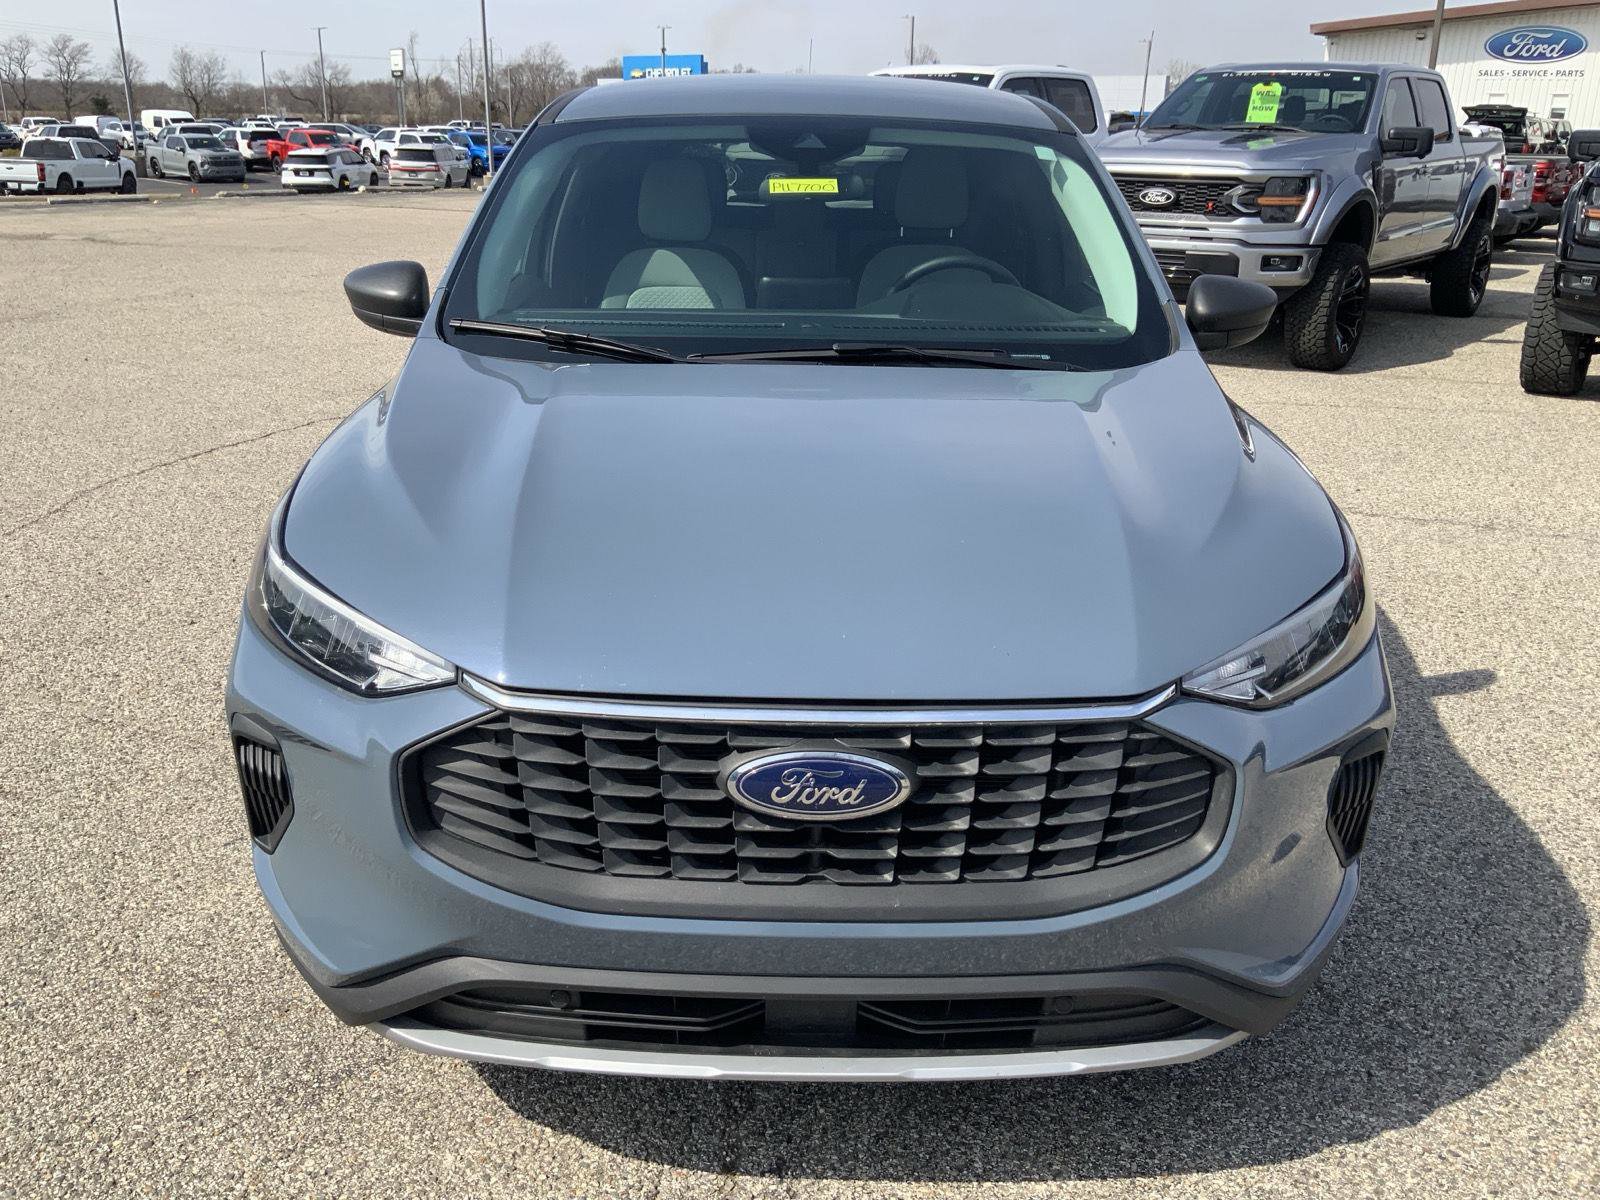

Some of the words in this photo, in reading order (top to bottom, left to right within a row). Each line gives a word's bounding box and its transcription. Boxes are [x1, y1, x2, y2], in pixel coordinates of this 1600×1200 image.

[1503, 31, 1568, 58] Ford
[1478, 69, 1505, 77] SALES
[1511, 69, 1548, 77] SERVICE
[1555, 69, 1585, 77] PARTS
[1145, 191, 1168, 202] Ford
[770, 767, 868, 805] Ford
